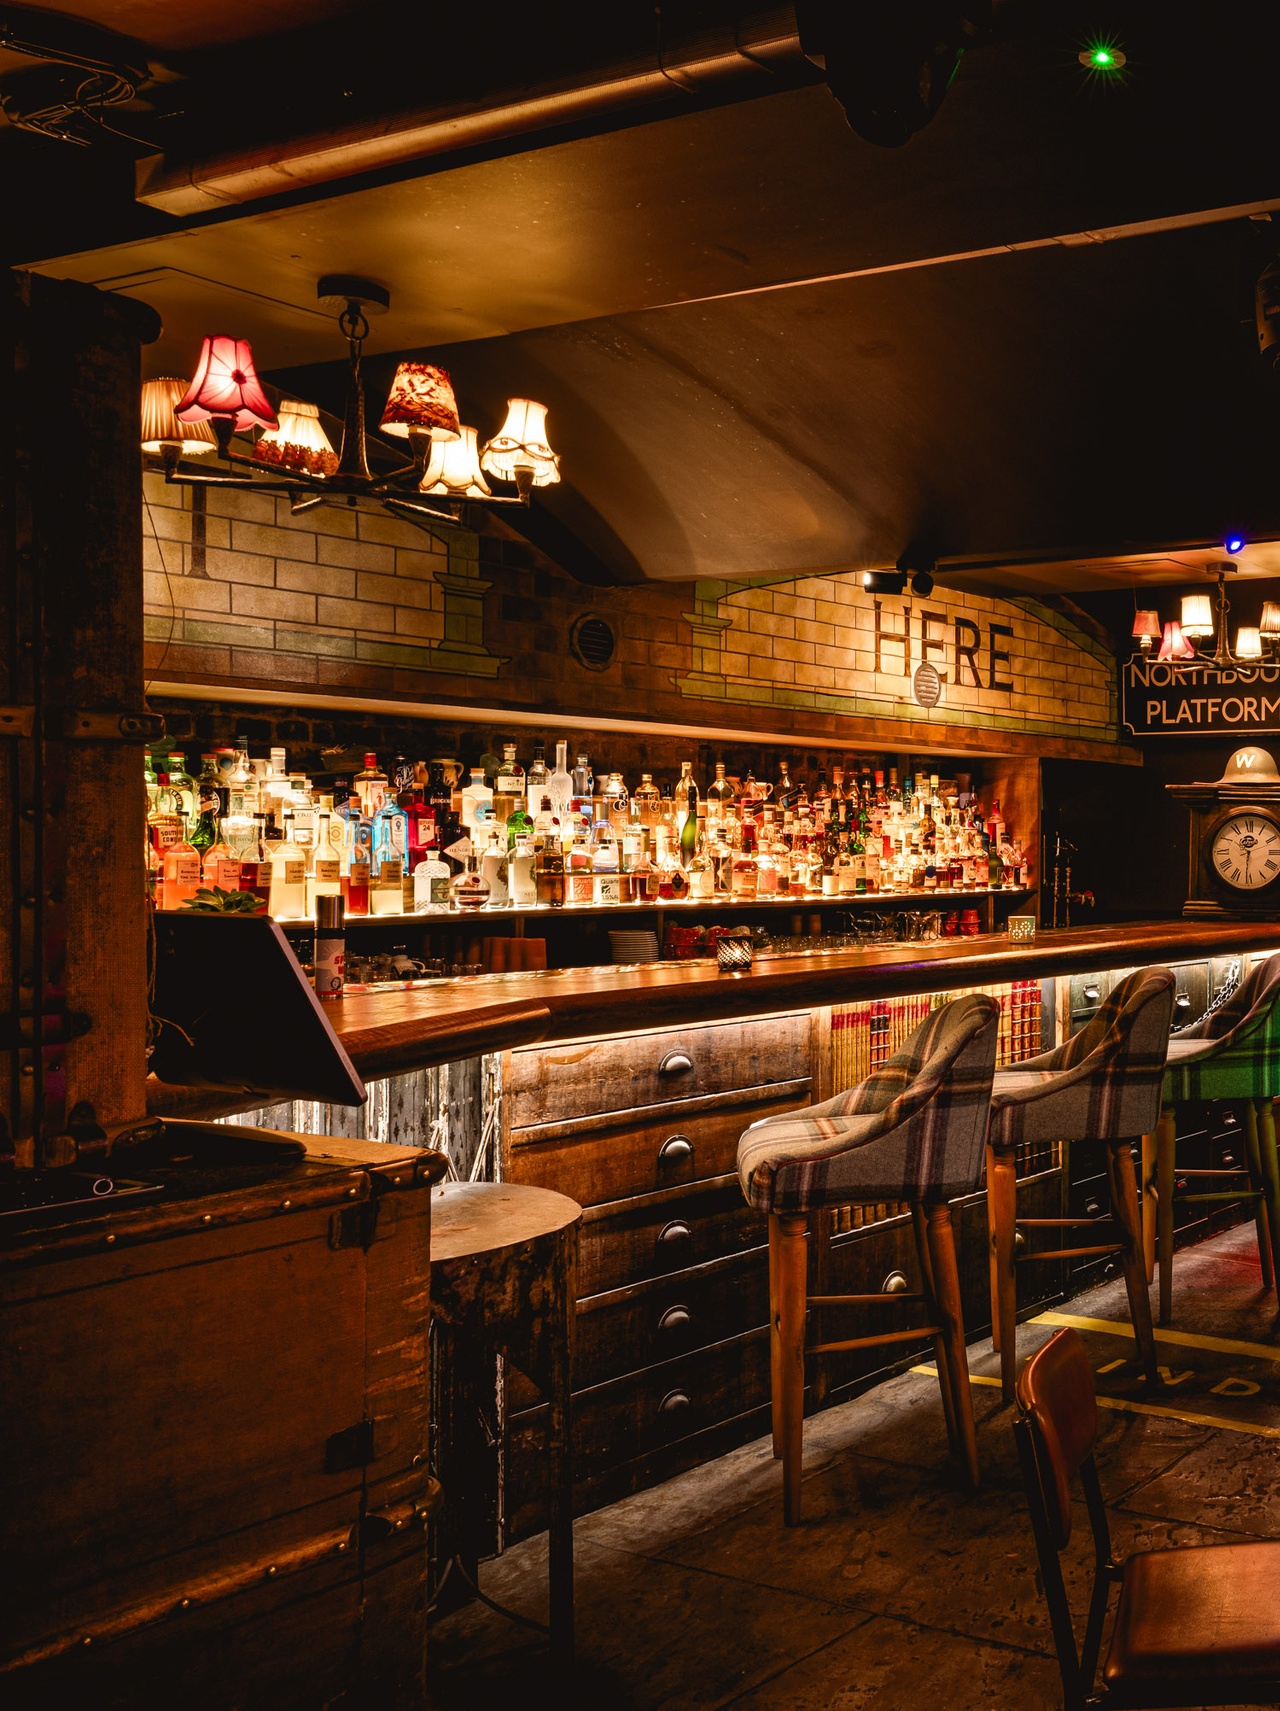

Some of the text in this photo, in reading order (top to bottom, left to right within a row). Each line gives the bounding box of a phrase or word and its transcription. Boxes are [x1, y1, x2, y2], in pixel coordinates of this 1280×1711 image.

[874, 600, 1014, 692] HERE
[1235, 754, 1255, 769] W
[1090, 1358, 1261, 1397] IND
